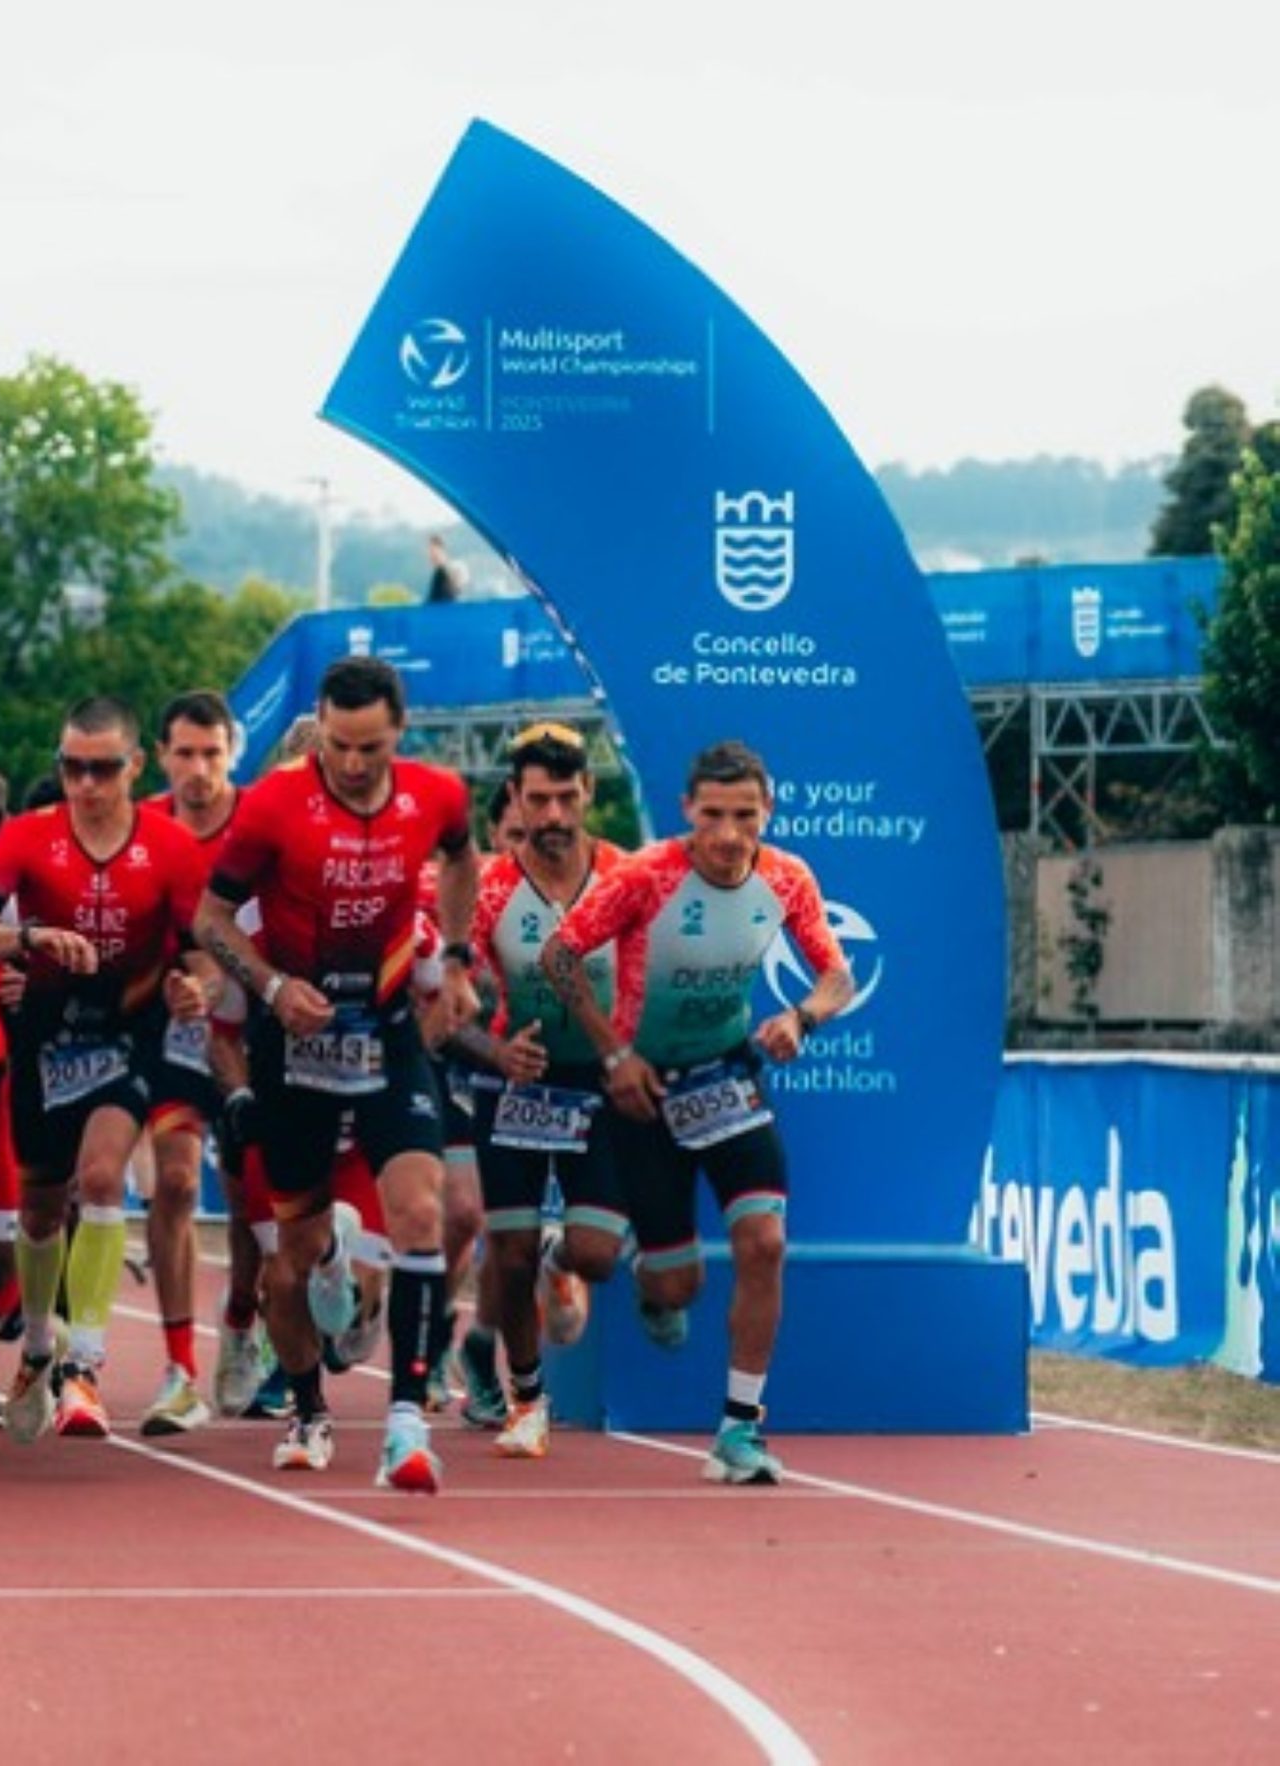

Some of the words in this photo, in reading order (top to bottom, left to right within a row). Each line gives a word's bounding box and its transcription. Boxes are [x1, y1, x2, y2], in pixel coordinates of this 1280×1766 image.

[500, 327, 624, 355] Multisport
[501, 358, 556, 374] World
[562, 357, 698, 378] Championships
[692, 632, 816, 656] Concello
[652, 664, 688, 685] de
[695, 664, 859, 686] Pontevedra
[804, 780, 877, 810] your
[330, 895, 387, 929] ESP
